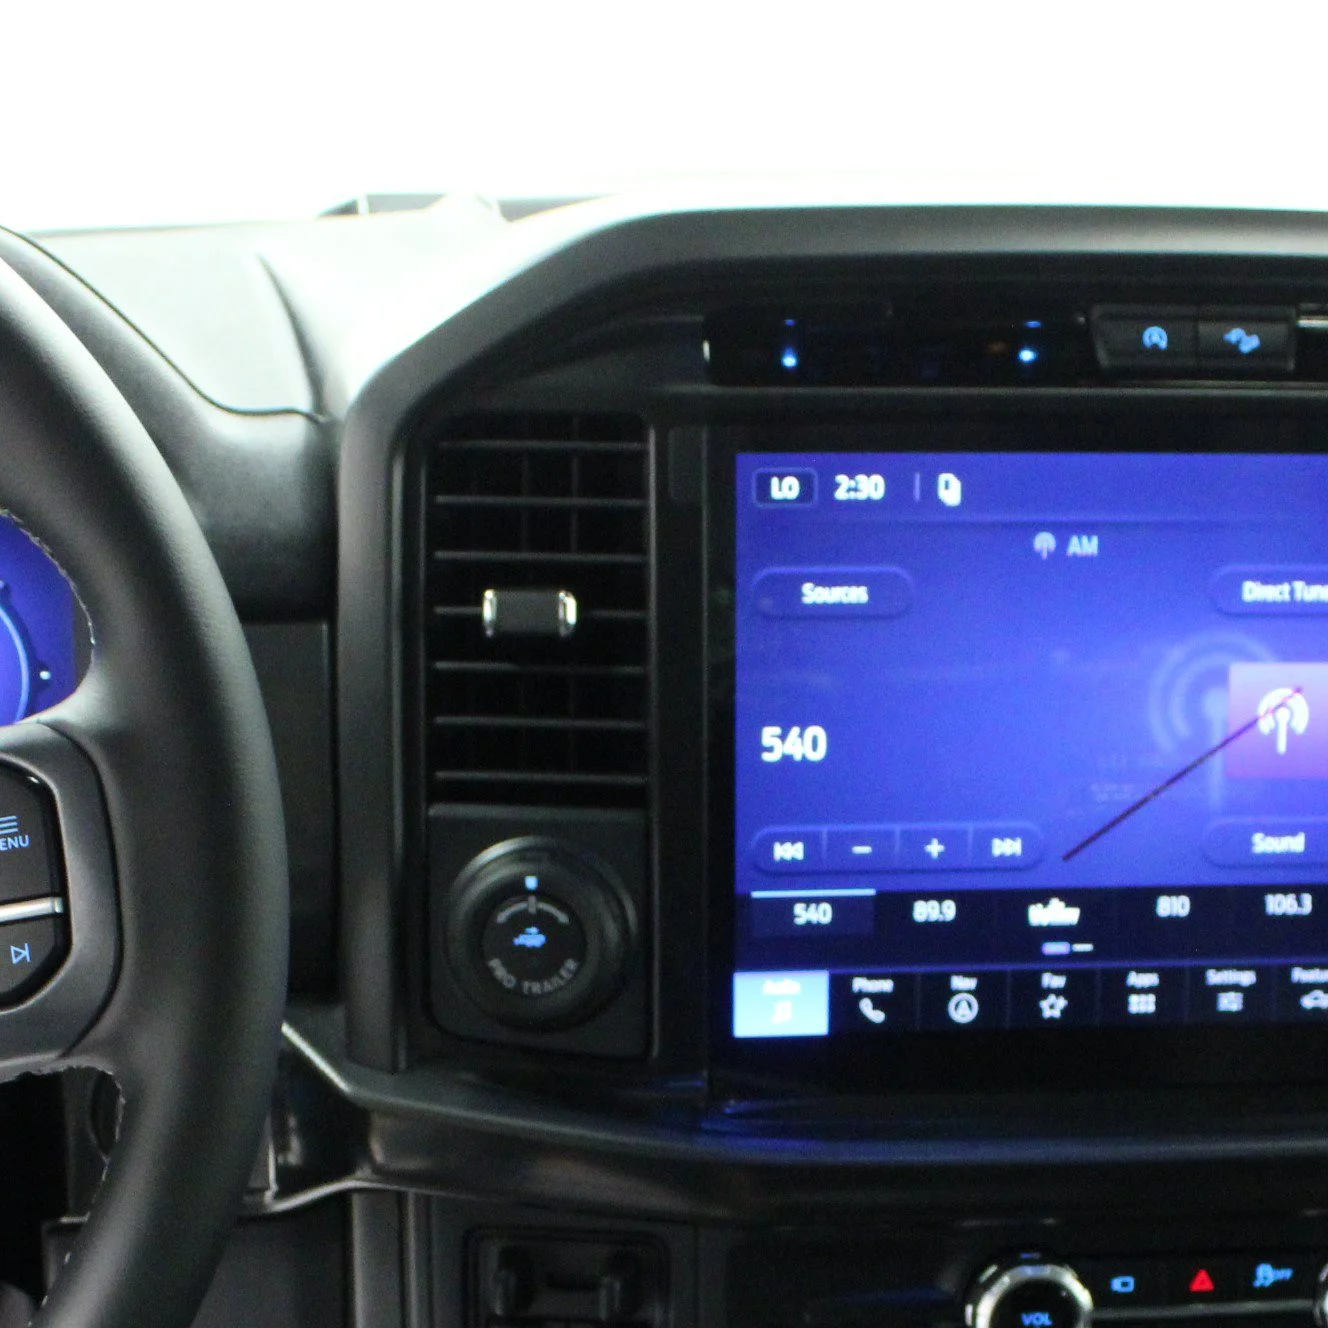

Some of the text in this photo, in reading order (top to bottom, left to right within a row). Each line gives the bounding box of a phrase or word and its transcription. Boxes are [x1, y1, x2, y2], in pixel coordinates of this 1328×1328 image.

[770, 476, 800, 500] LO
[834, 474, 885, 500] 2:30
[1067, 535, 1099, 556] AM
[801, 582, 869, 605] Sources
[1241, 581, 1290, 603] Direct
[761, 725, 827, 762] 540
[1252, 832, 1305, 854] Sound
[793, 903, 833, 925] 540
[912, 900, 957, 922] 89.9
[1156, 895, 1191, 917] 810
[1264, 893, 1313, 916] 106.3
[851, 976, 894, 994] Phone
[1205, 968, 1257, 987] Settings
[1021, 1311, 1052, 1328] VOL
